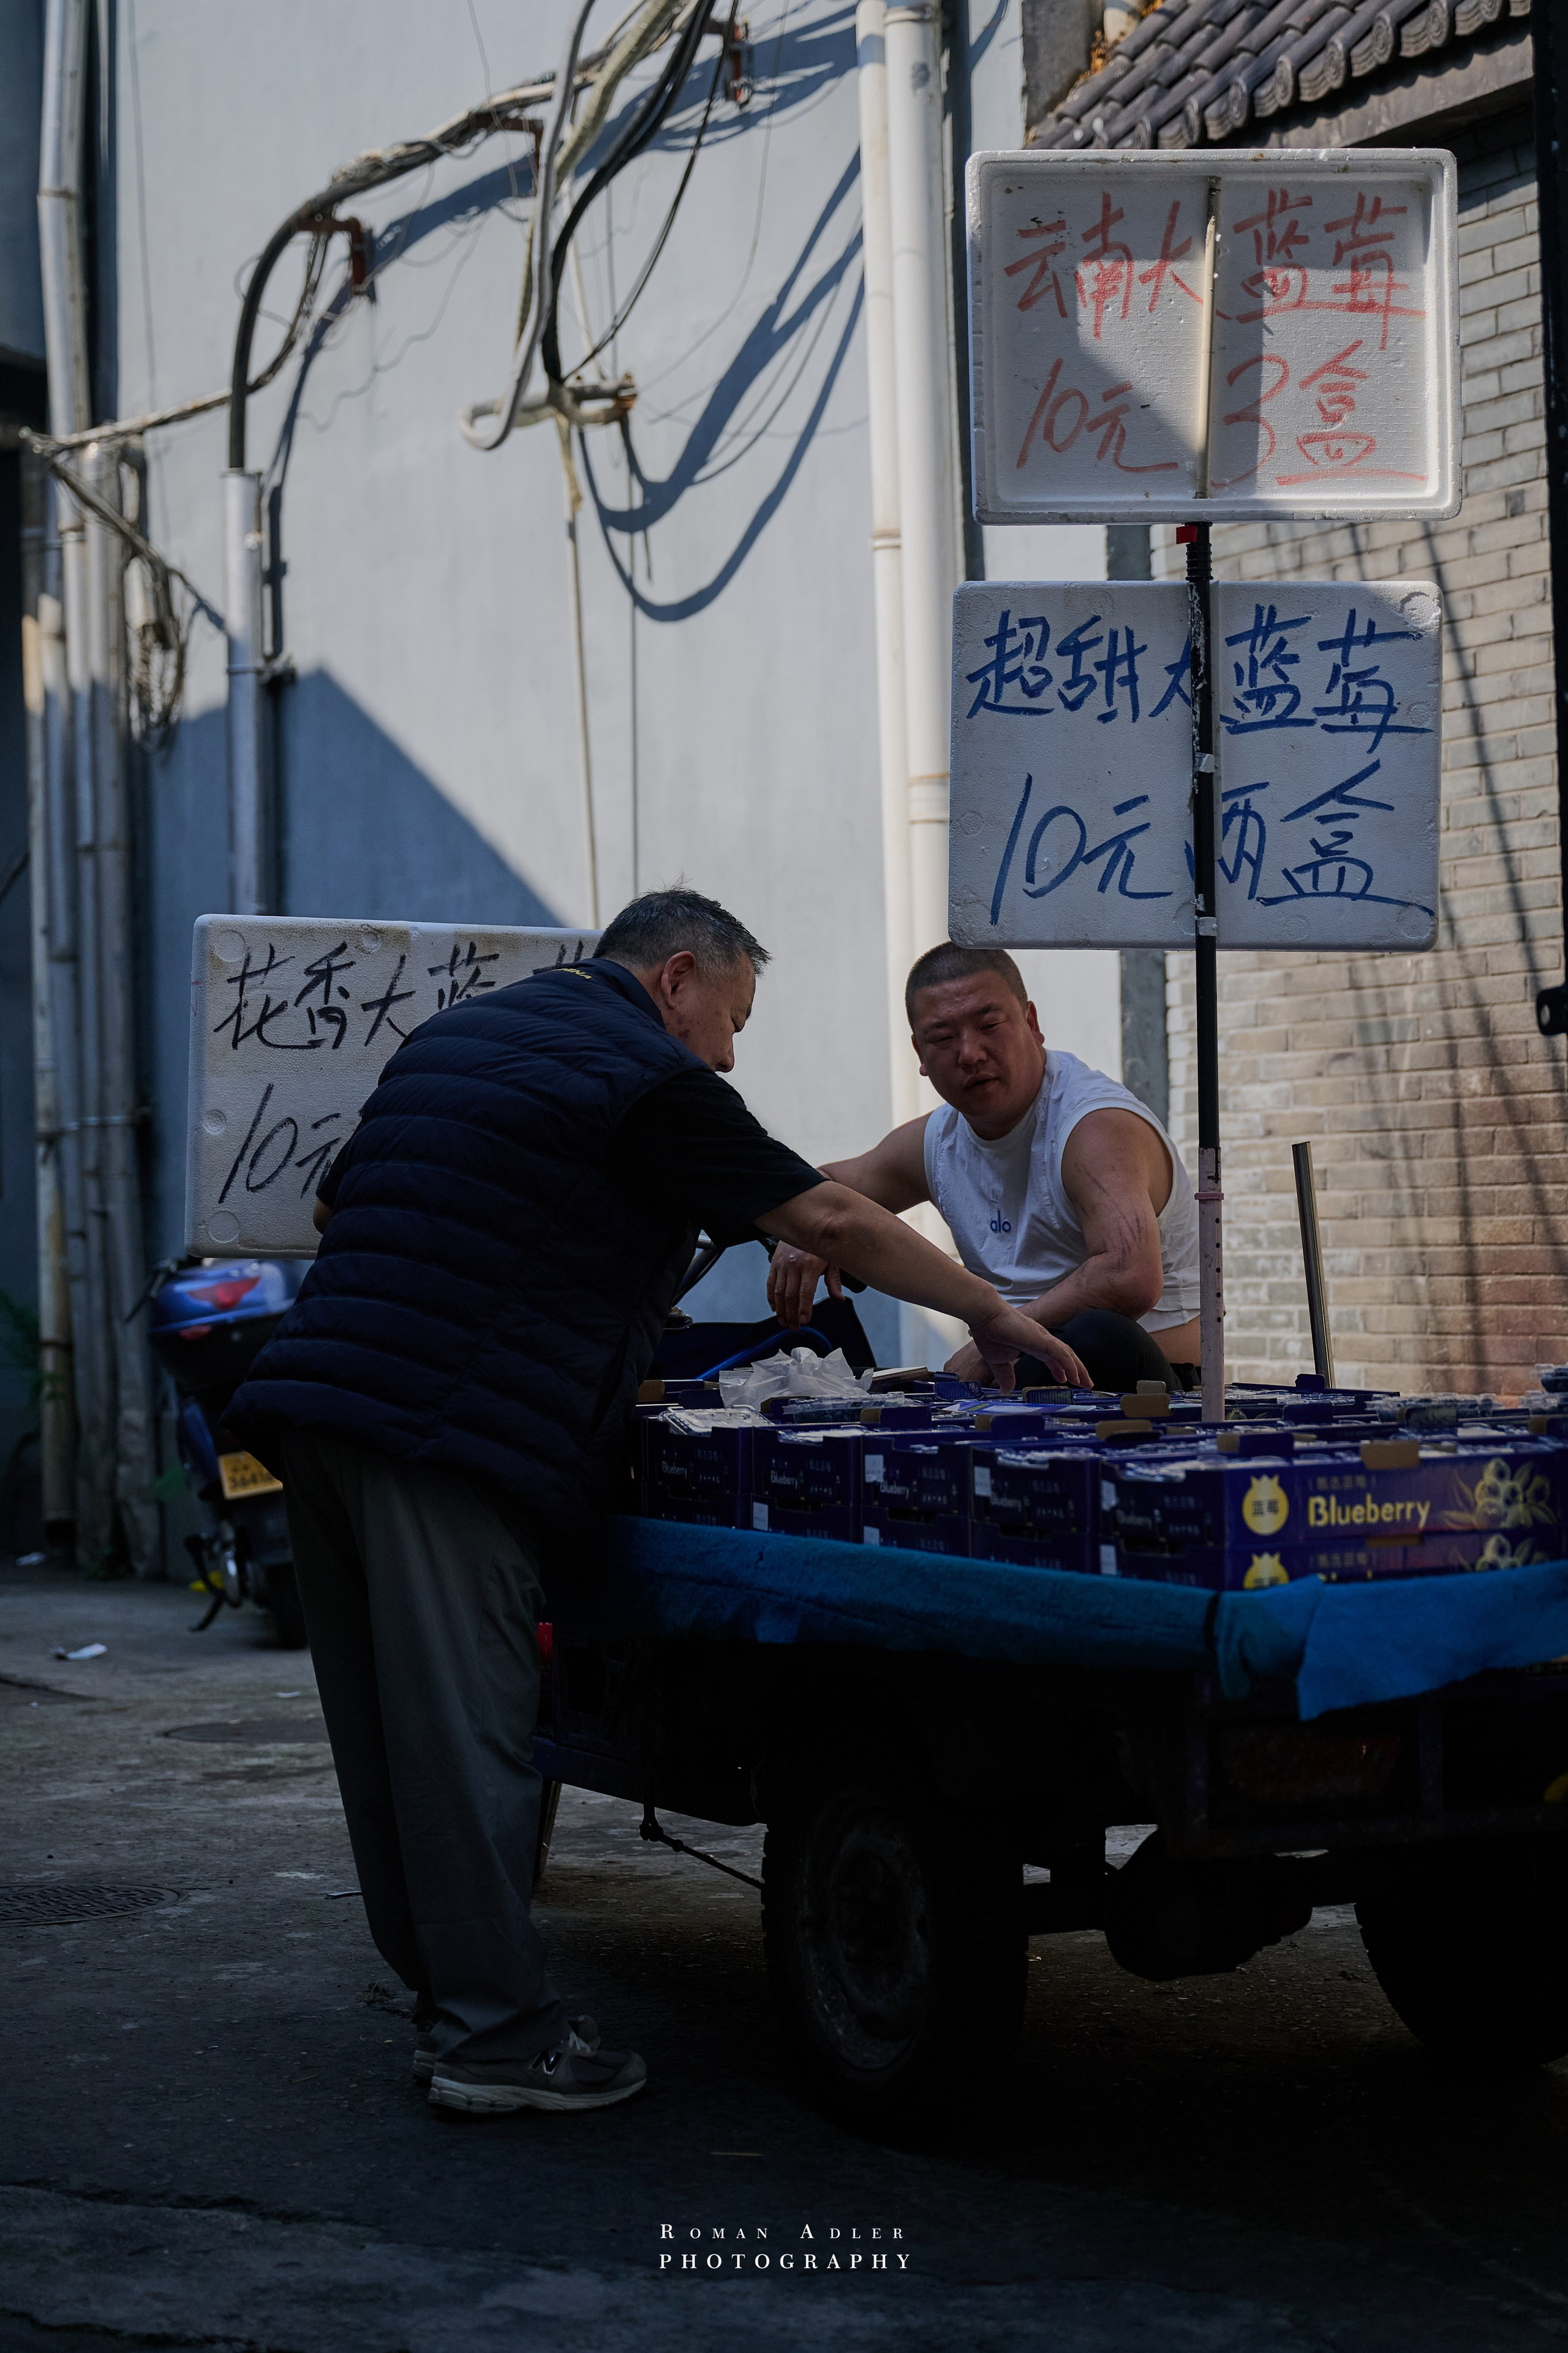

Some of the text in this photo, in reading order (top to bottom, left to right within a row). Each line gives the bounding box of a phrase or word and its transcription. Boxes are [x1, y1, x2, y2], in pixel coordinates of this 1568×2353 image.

[990, 1208, 1011, 1233] alo
[662, 1460, 688, 1479] Blueberry
[771, 1470, 799, 1490] Blueberry
[1308, 1492, 1431, 1530] Blueberry
